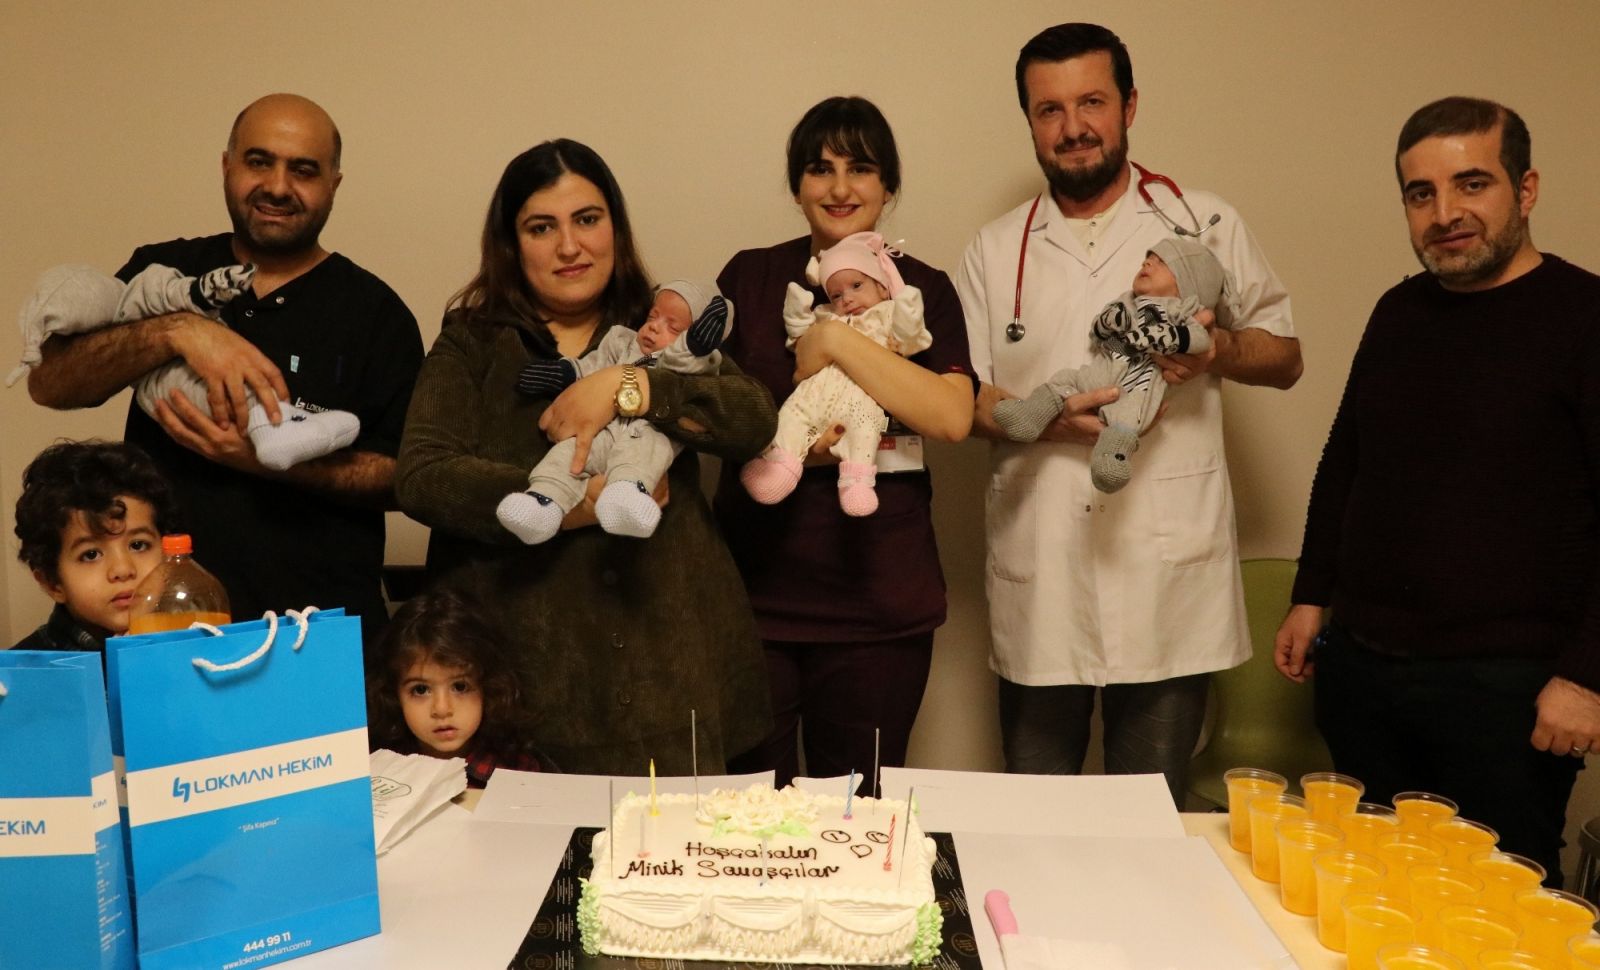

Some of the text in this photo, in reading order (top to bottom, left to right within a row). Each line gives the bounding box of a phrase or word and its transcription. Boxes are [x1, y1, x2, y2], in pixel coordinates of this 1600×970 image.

[194, 766, 274, 793] LOKMAN
[618, 859, 684, 880] Minik
[243, 931, 291, 953] 444 99 11
